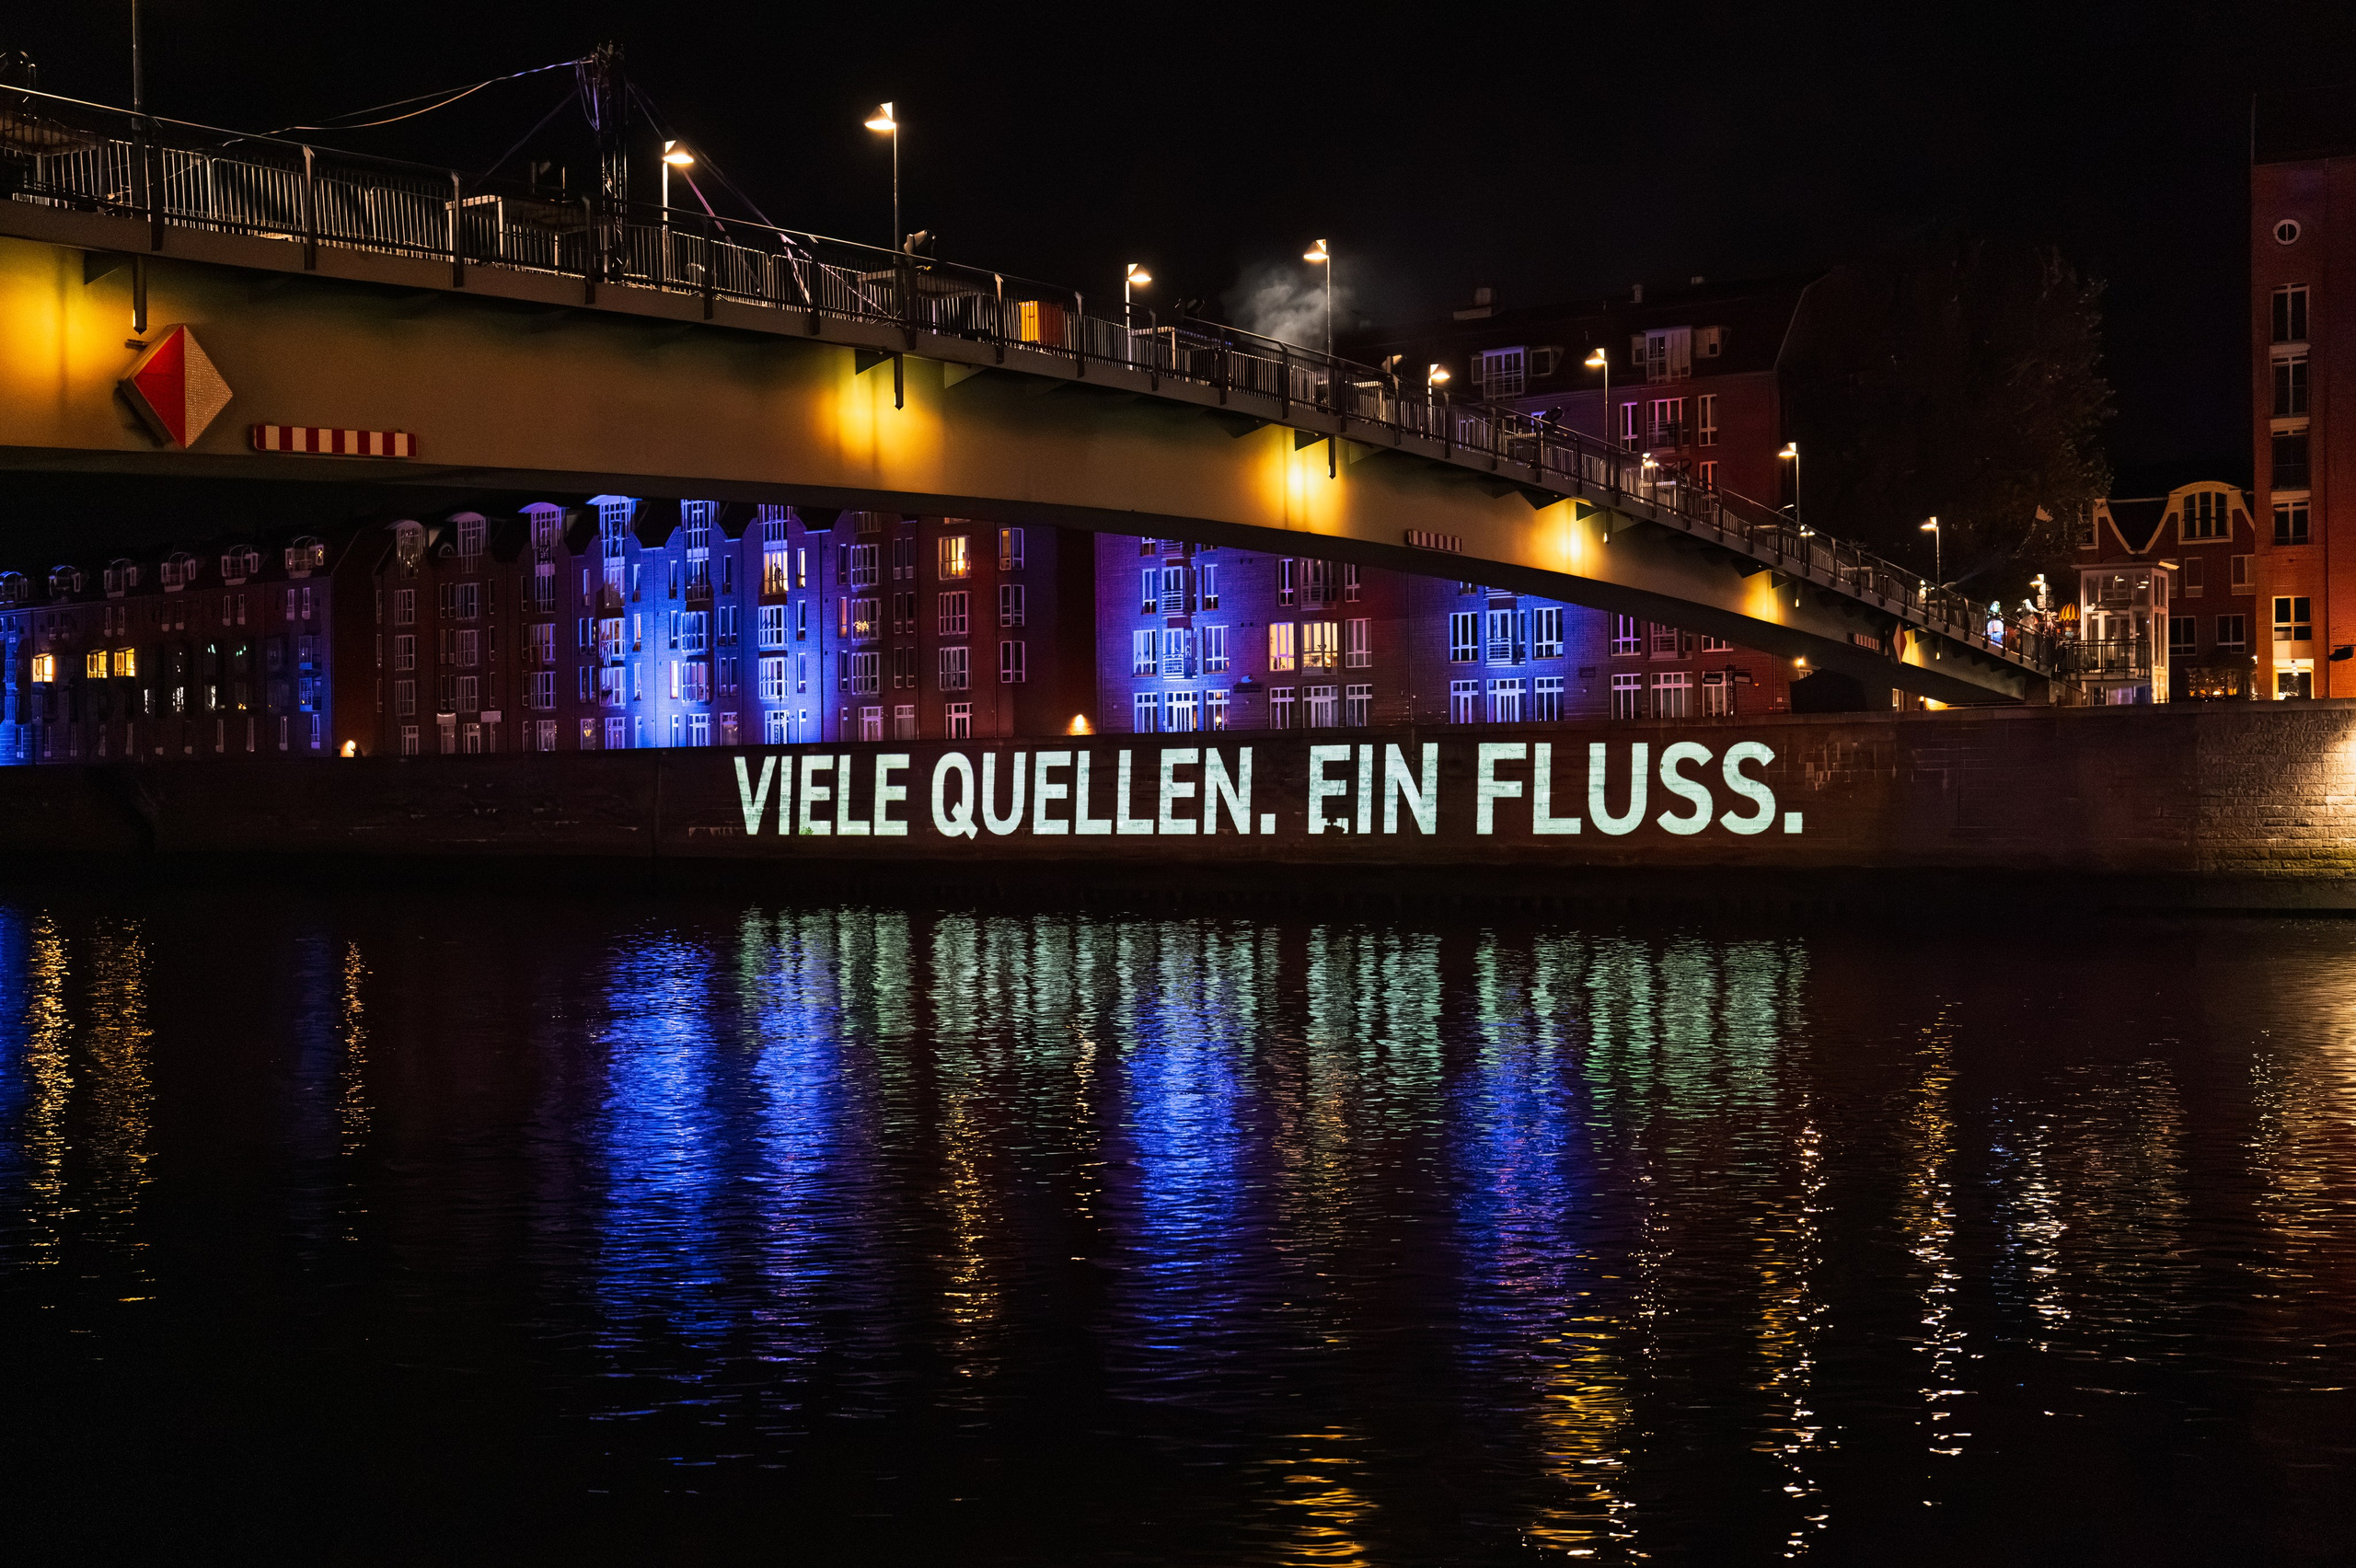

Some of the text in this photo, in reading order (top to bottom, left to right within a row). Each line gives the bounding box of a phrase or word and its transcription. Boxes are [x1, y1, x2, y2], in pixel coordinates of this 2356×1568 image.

[733, 741, 1804, 840] VIELE QUELLEN. EIN FLUSS.
